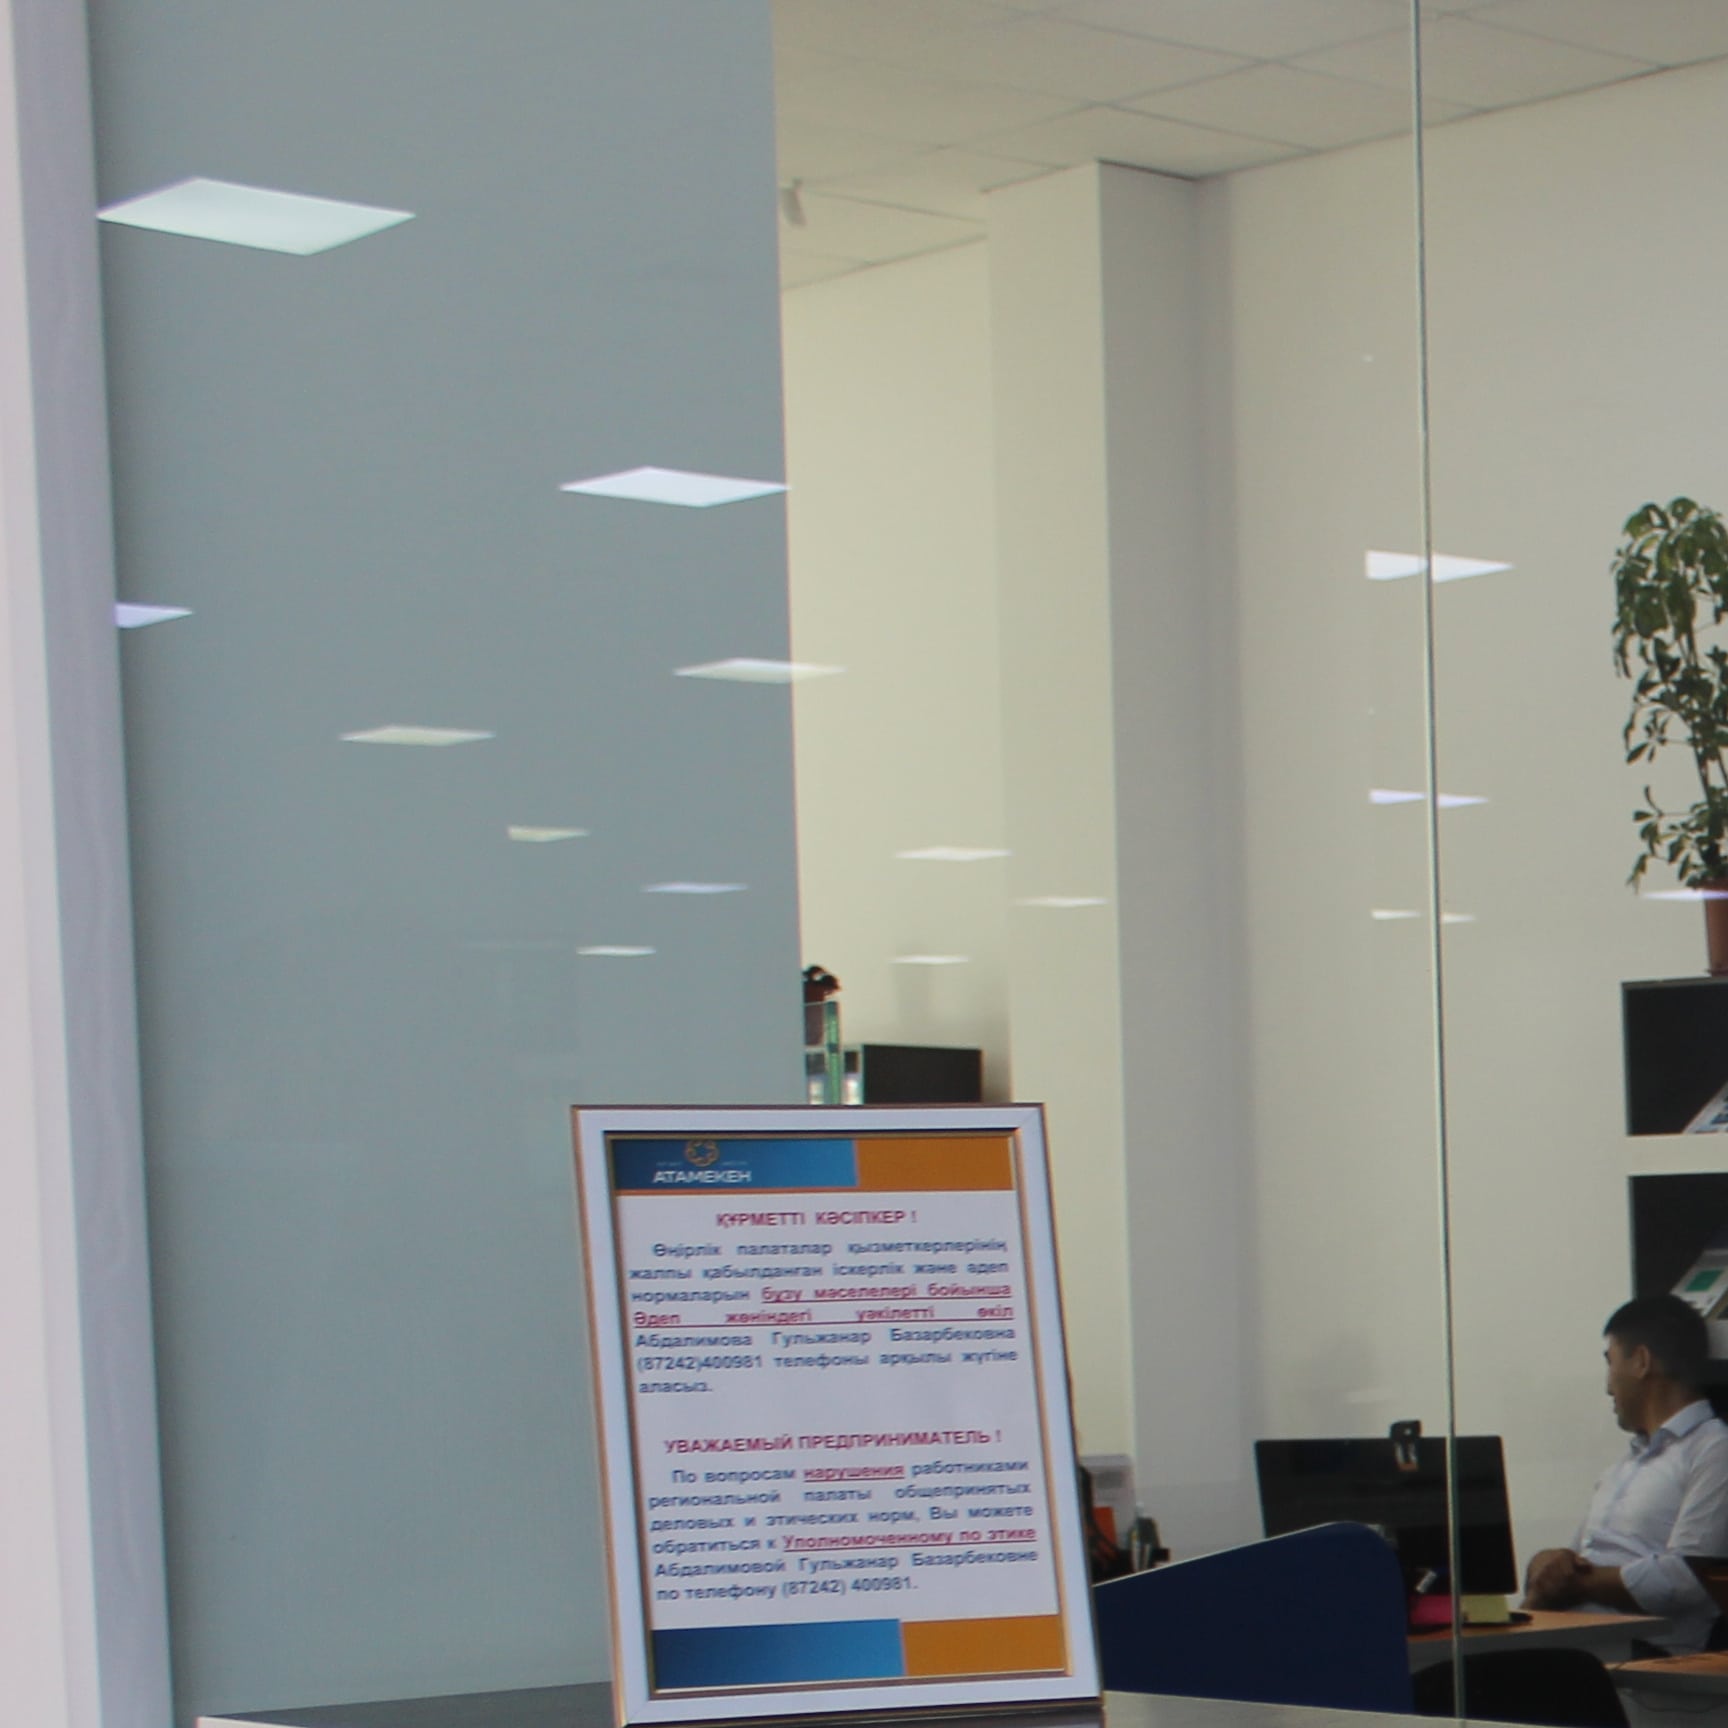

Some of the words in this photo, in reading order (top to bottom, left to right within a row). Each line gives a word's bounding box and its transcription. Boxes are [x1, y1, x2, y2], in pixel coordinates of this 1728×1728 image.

[653, 1168, 752, 1185] АТАМЕКЕН
[717, 1213, 805, 1229] ҚҰРМЕТТІ
[816, 1211, 906, 1226] КӘСІПКЕР
[737, 1243, 832, 1257] палаталар
[629, 1267, 691, 1281] жалпы
[631, 1289, 749, 1305] нормаларын
[928, 1282, 1011, 1298] бойынша
[636, 1332, 752, 1349] Абдалимова
[772, 1330, 871, 1348] Гульжанар
[891, 1328, 1014, 1343] Базарбековна
[774, 1352, 869, 1370] телефоны
[639, 1379, 712, 1394] аласыз.
[665, 1435, 792, 1454] УВАЖАЕМЫЙ
[799, 1431, 990, 1449] ПРЕДПРИНИМАТЕЛЬ
[673, 1469, 697, 1484] По
[705, 1467, 795, 1484] вопросам
[804, 1464, 904, 1481] нарушения
[911, 1459, 1028, 1477] работниками
[648, 1490, 780, 1509] региональной
[804, 1488, 871, 1502] палаты
[894, 1482, 1031, 1500] общепринятых
[650, 1515, 734, 1532] деловых
[765, 1511, 857, 1526] этических
[930, 1507, 958, 1521] Вы
[968, 1506, 1033, 1519] можете
[653, 1538, 761, 1555] обратиться
[783, 1532, 953, 1550] Уполномоченному
[959, 1529, 982, 1544] по
[988, 1527, 1036, 1540] этике
[655, 1559, 785, 1578] Абдалимовой
[799, 1554, 898, 1572] Гульжанар
[911, 1550, 1037, 1567] Базарбековне
[656, 1587, 679, 1603] по
[685, 1582, 776, 1601] телефону
[782, 1578, 846, 1597] (87242)
[851, 1576, 917, 1592] 400981.
